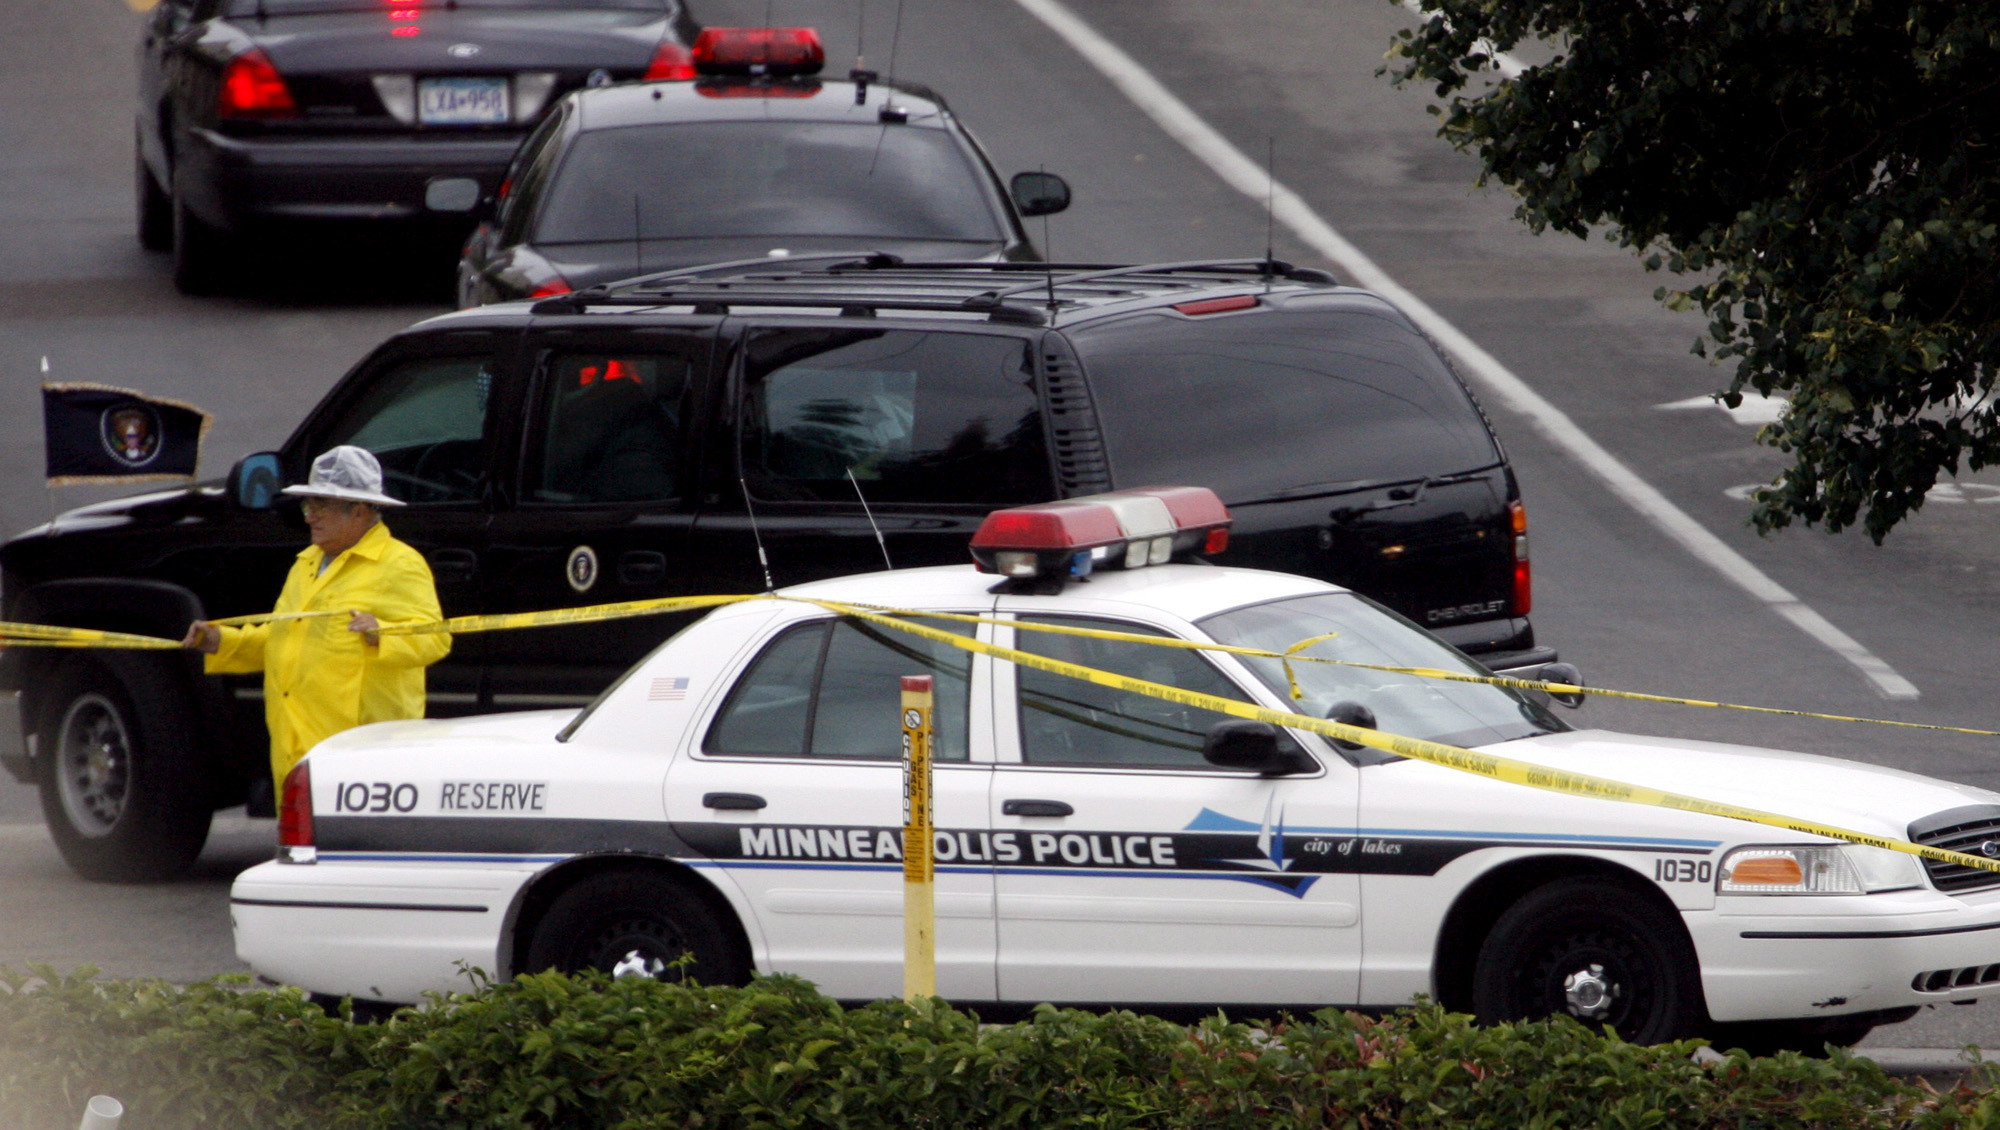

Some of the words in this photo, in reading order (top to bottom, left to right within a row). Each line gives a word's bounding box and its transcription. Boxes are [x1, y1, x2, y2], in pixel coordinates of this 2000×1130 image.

[1427, 600, 1504, 621] CHEVROLET
[910, 761, 918, 796] GAS
[336, 782, 418, 813] 1030
[440, 783, 545, 810] RESERVE
[739, 827, 1021, 862] MINNEAOLIS
[1031, 833, 1176, 866] POLICE
[1304, 838, 1332, 855] city
[1338, 839, 1356, 855] of
[1361, 839, 1402, 855] lakes
[1655, 859, 1712, 883] 1030
